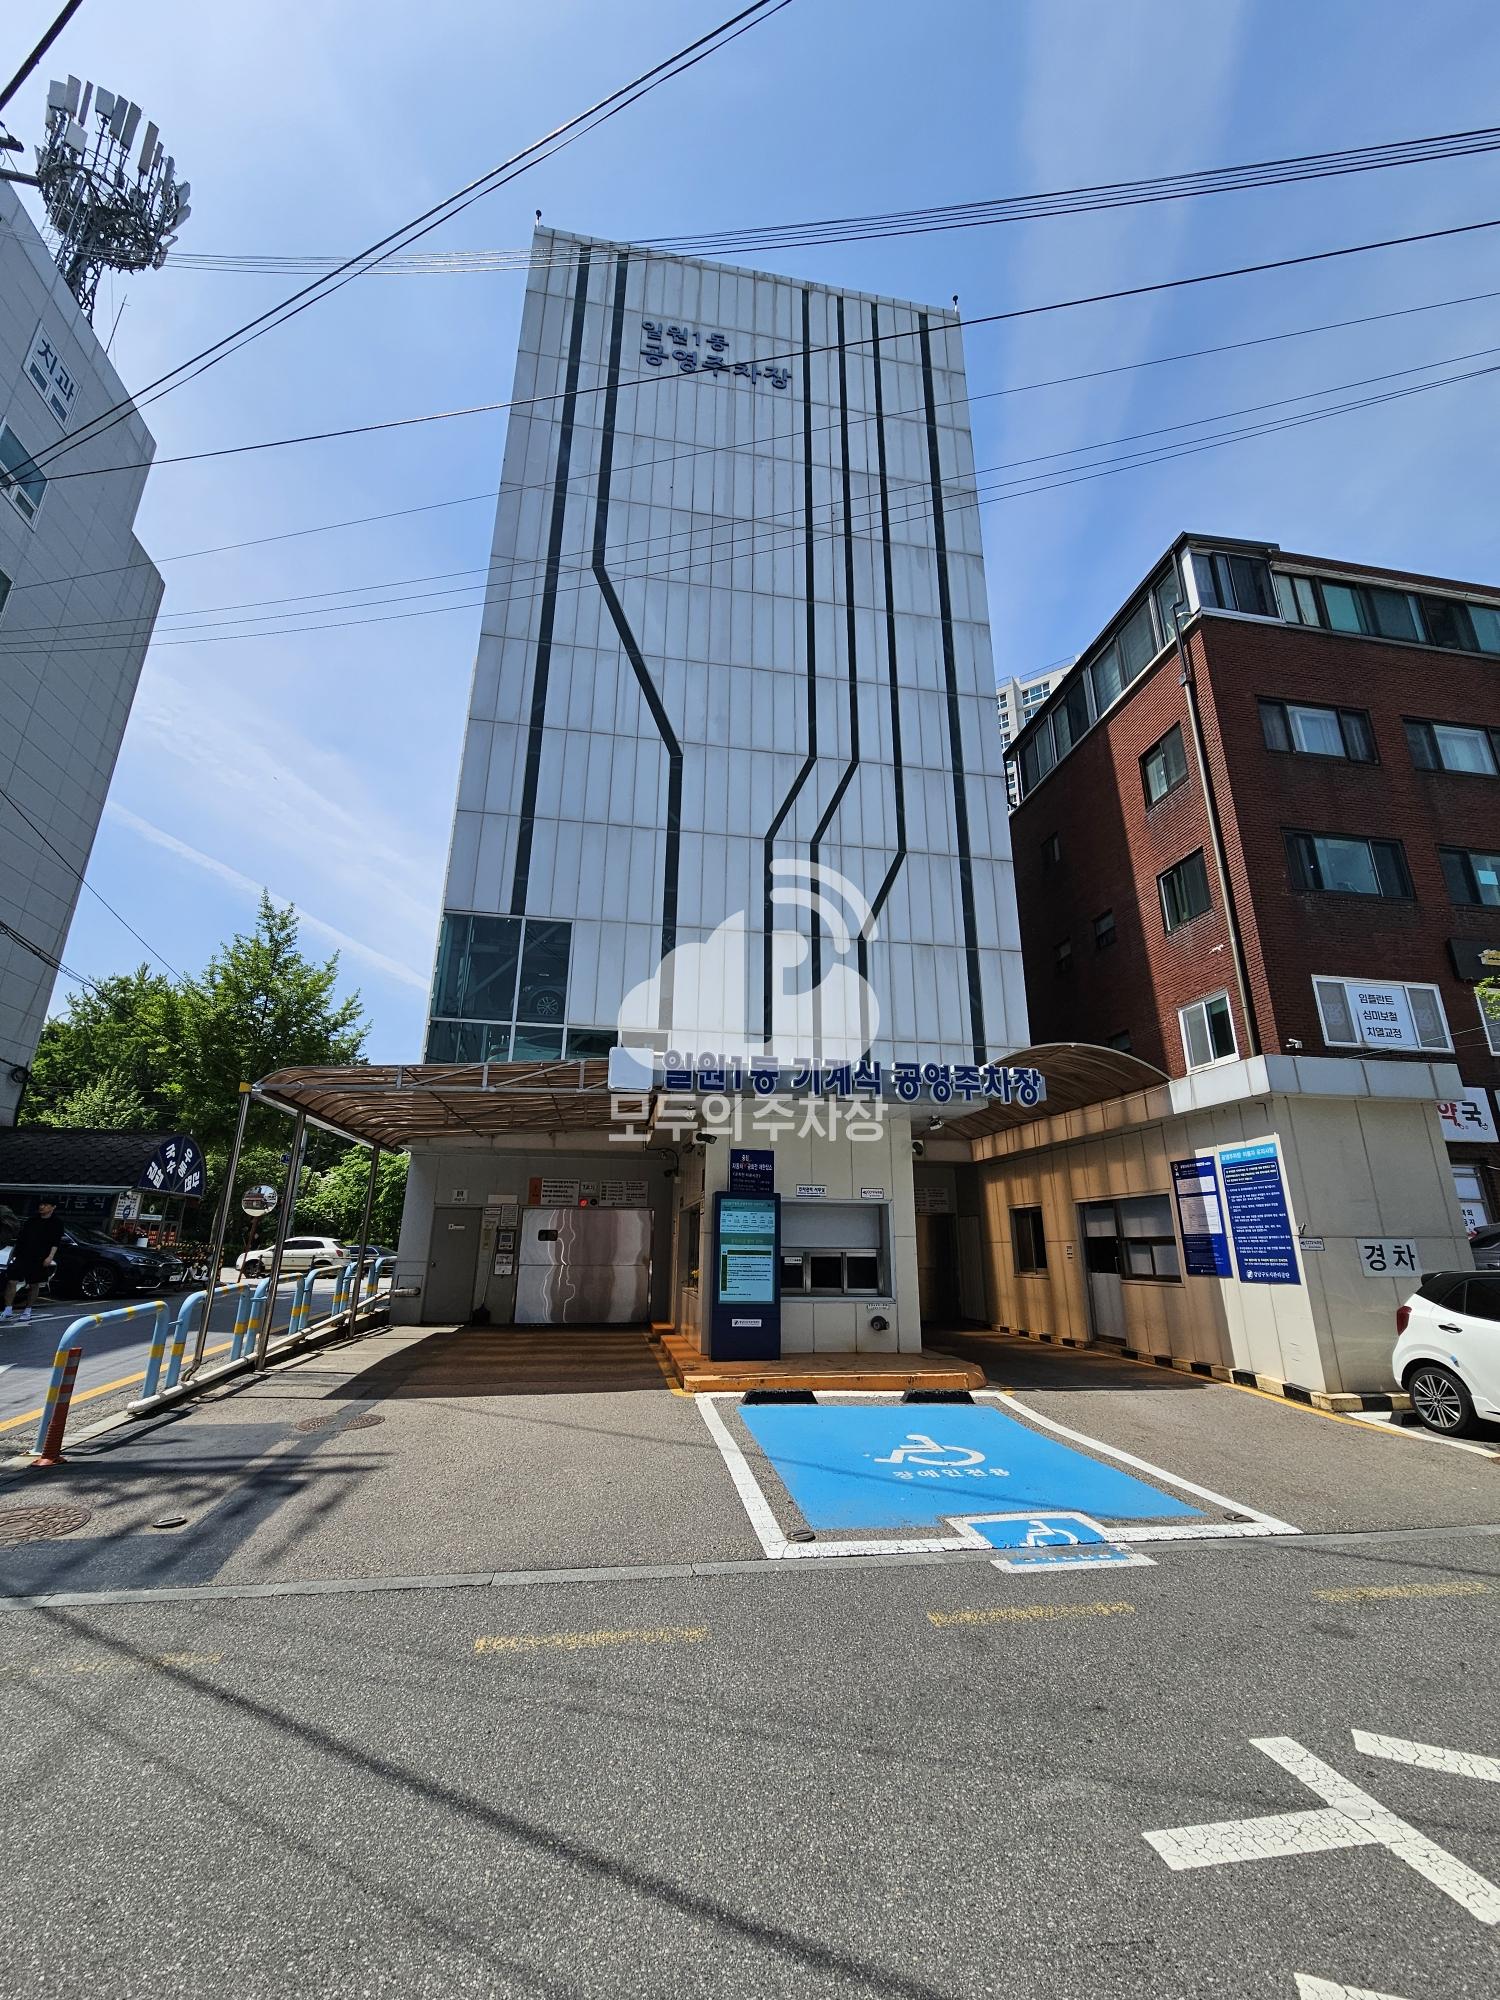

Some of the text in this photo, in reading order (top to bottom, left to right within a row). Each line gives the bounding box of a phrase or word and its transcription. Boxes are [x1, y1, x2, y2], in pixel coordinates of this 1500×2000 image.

[642, 320, 729, 352] 일원1동
[37, 339, 75, 402] 치과
[640, 343, 792, 389] 공영주차장
[1358, 993, 1395, 1005] 임플란트
[1362, 1010, 1398, 1022] 심미보철
[1366, 1027, 1403, 1039] 치열교정
[661, 1049, 1046, 1108] 일원1동 기계식 공영주차장
[1436, 1101, 1489, 1131] 약국
[165, 1143, 177, 1175] 국수
[177, 1147, 193, 1178] 우동
[1363, 1243, 1416, 1272] 경차
[892, 1468, 1010, 1480] 장애인전용
